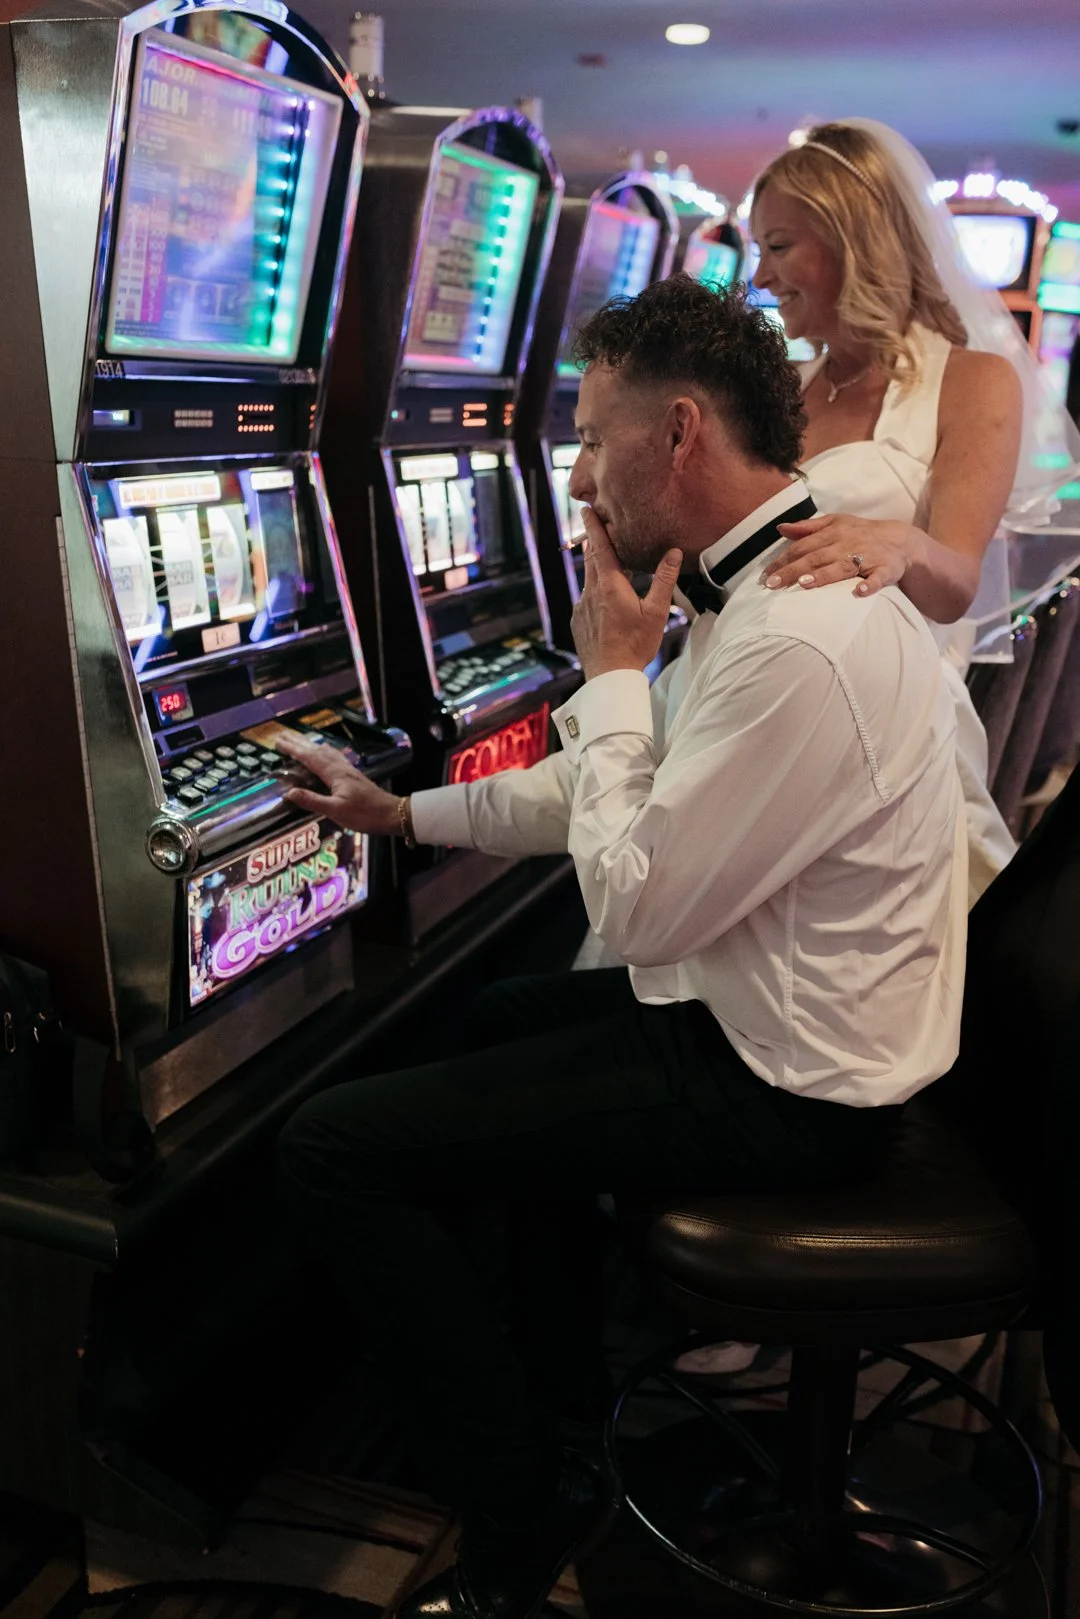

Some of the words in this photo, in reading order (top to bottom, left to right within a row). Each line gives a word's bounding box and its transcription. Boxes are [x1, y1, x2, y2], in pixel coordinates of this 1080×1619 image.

[160, 693, 180, 712] 250
[228, 840, 339, 931] RUINS
[248, 824, 319, 881] SUPER
[212, 868, 349, 978] GOLD
